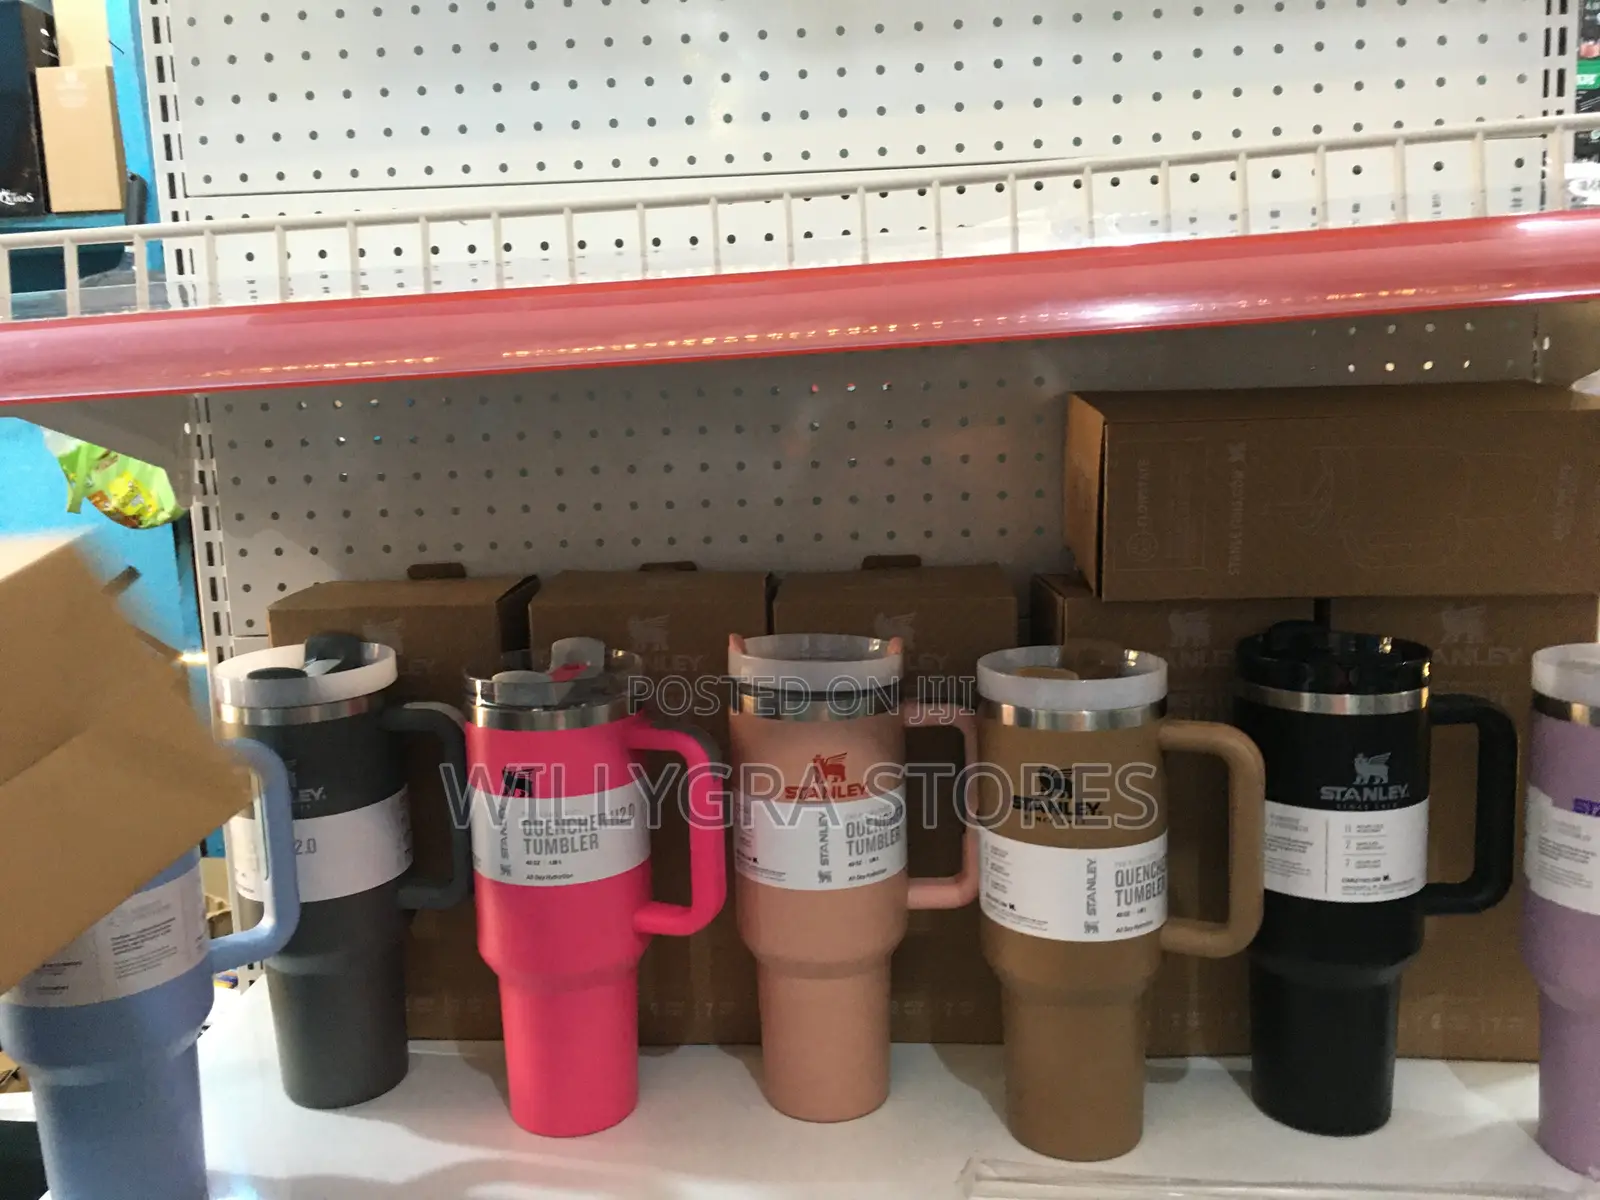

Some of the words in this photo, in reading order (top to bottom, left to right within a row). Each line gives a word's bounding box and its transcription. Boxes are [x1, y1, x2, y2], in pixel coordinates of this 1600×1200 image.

[785, 782, 867, 800] STANLEY
[1319, 784, 1410, 801] STANLEY
[1012, 794, 1101, 816] STANLEY
[520, 812, 608, 838] QUENCHER
[522, 833, 599, 856] TUMBLER
[818, 811, 830, 866] STANLEY
[1085, 857, 1098, 917] STANLEY
